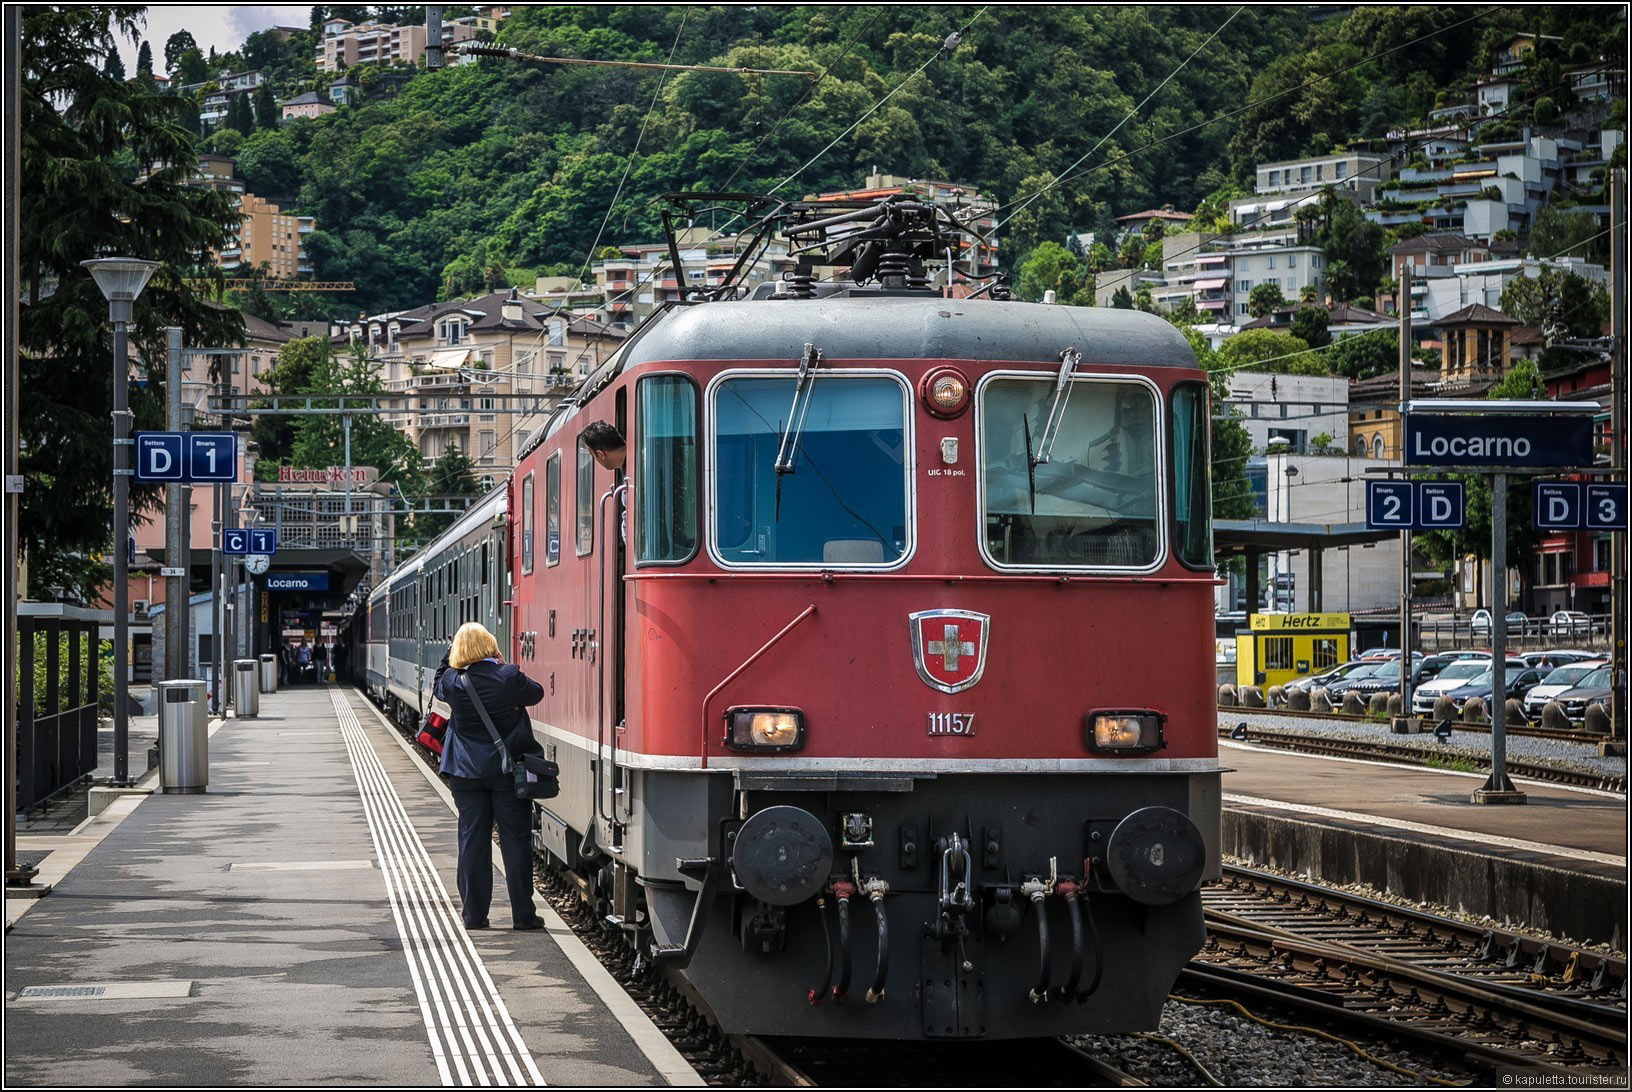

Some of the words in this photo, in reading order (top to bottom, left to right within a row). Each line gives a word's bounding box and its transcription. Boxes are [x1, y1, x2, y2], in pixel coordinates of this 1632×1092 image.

[1415, 431, 1531, 457] Locarno
[150, 448, 172, 473] D
[205, 448, 216, 473] 1
[1383, 495, 1401, 520] 2
[1431, 496, 1452, 521] D
[1549, 497, 1569, 521] D
[1598, 498, 1616, 523] 3
[230, 536, 243, 550] C
[259, 536, 266, 550] 1
[267, 578, 308, 588] Locarno
[1281, 615, 1321, 628] Hertz
[929, 712, 975, 735] 11157
